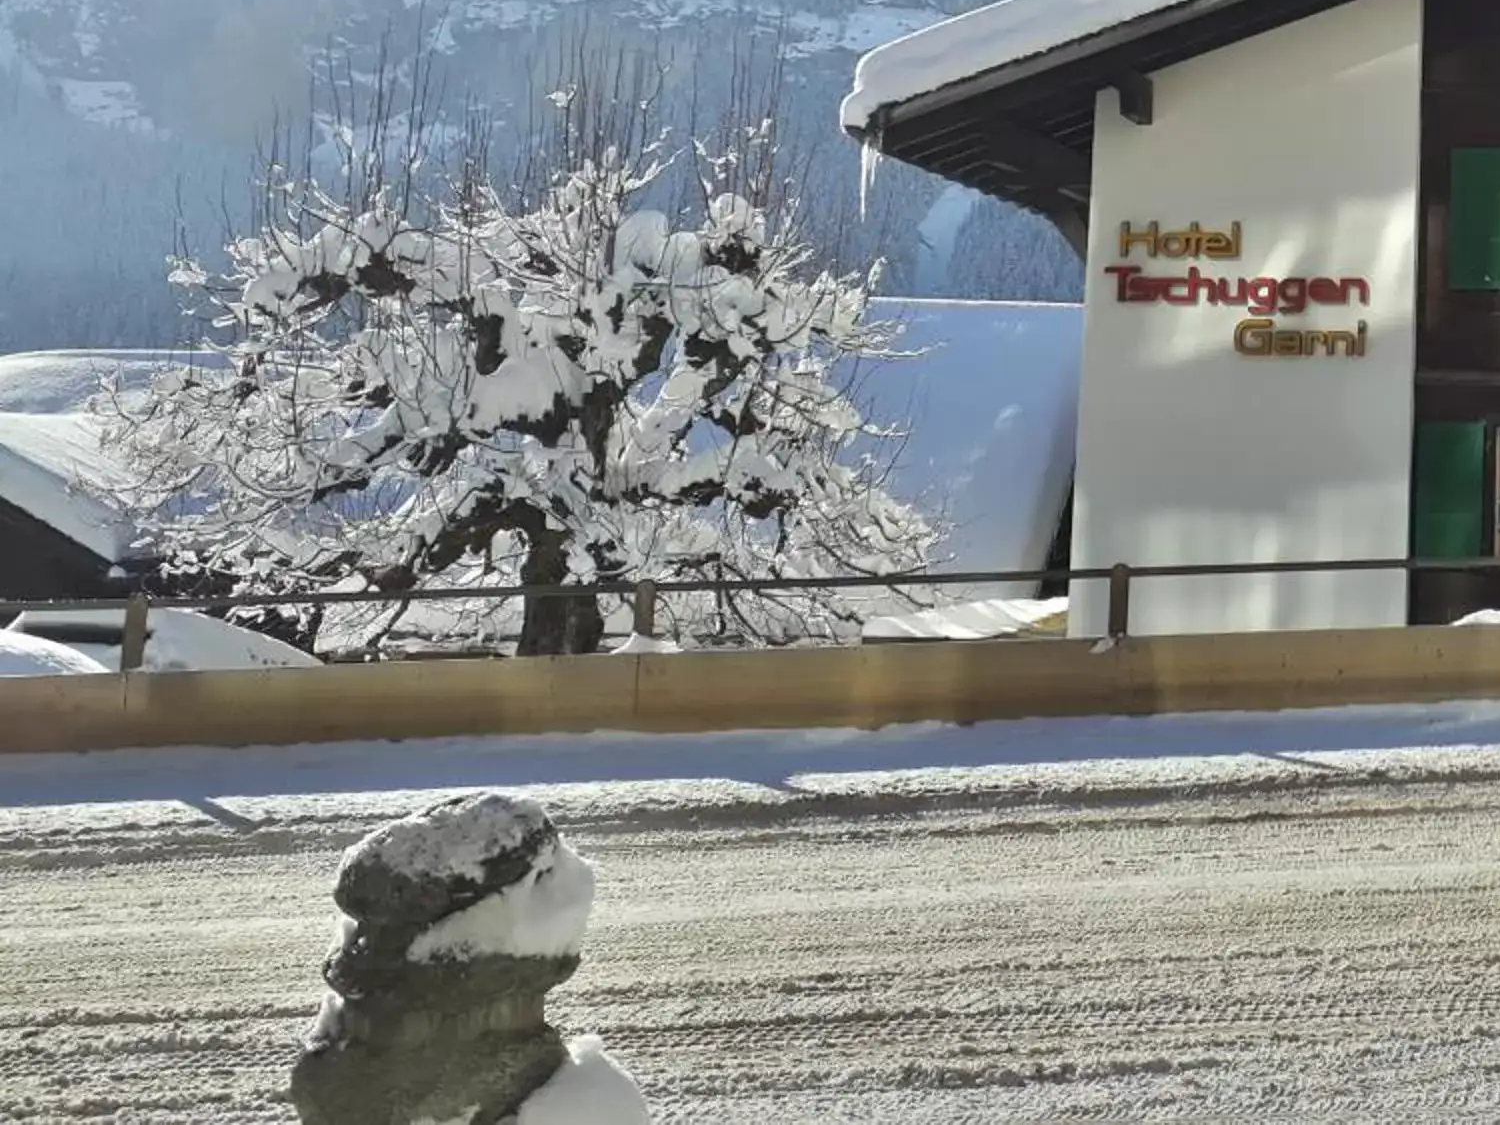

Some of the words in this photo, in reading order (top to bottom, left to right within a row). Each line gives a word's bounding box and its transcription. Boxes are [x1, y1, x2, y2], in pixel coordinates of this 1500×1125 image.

[1119, 220, 1242, 259] Hotel
[1104, 266, 1370, 315] Tschuggen
[1233, 319, 1368, 358] Garni
